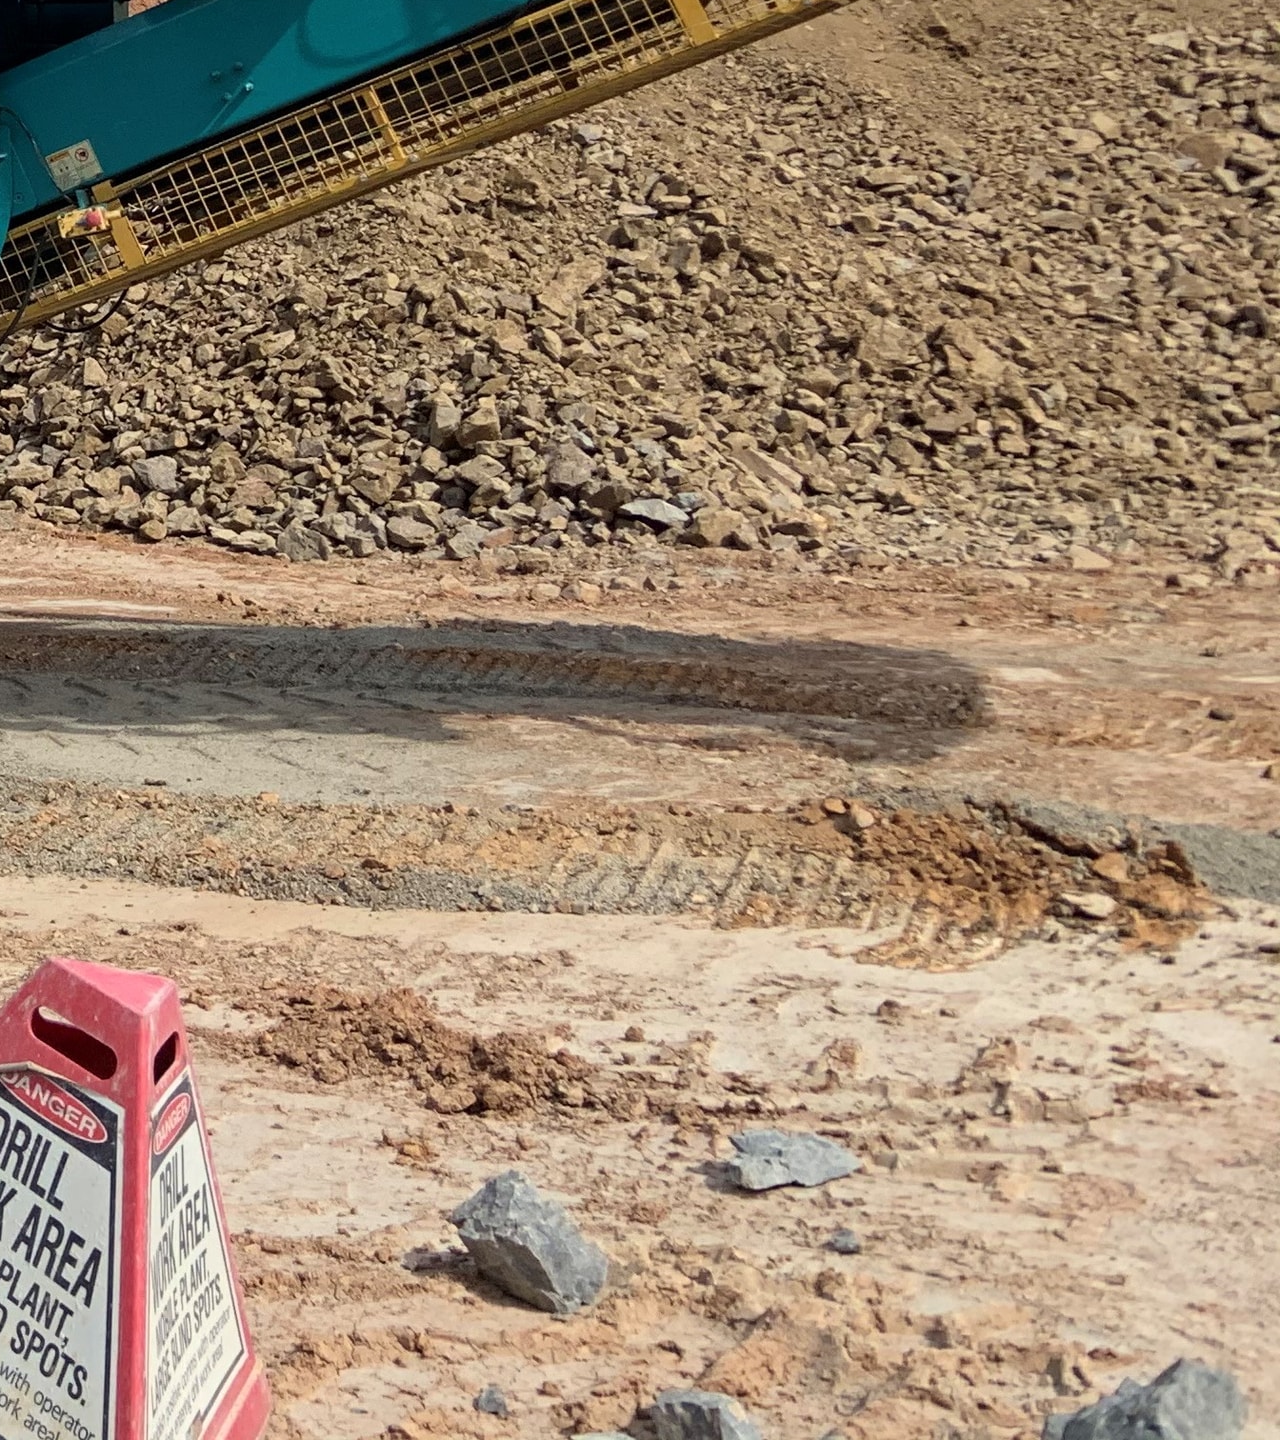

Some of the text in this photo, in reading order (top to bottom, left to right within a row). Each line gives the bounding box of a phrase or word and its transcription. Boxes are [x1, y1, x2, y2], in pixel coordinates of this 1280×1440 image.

[154, 1099, 187, 1152] DANGER
[160, 1145, 189, 1228] DRILL
[11, 1204, 103, 1309] AREA
[151, 1183, 211, 1315] WORK AREA
[10, 1320, 88, 1407] SPOTS.
[171, 1312, 192, 1372] BLIND
[0, 1361, 31, 1396] with
[33, 1390, 96, 1440] operator
